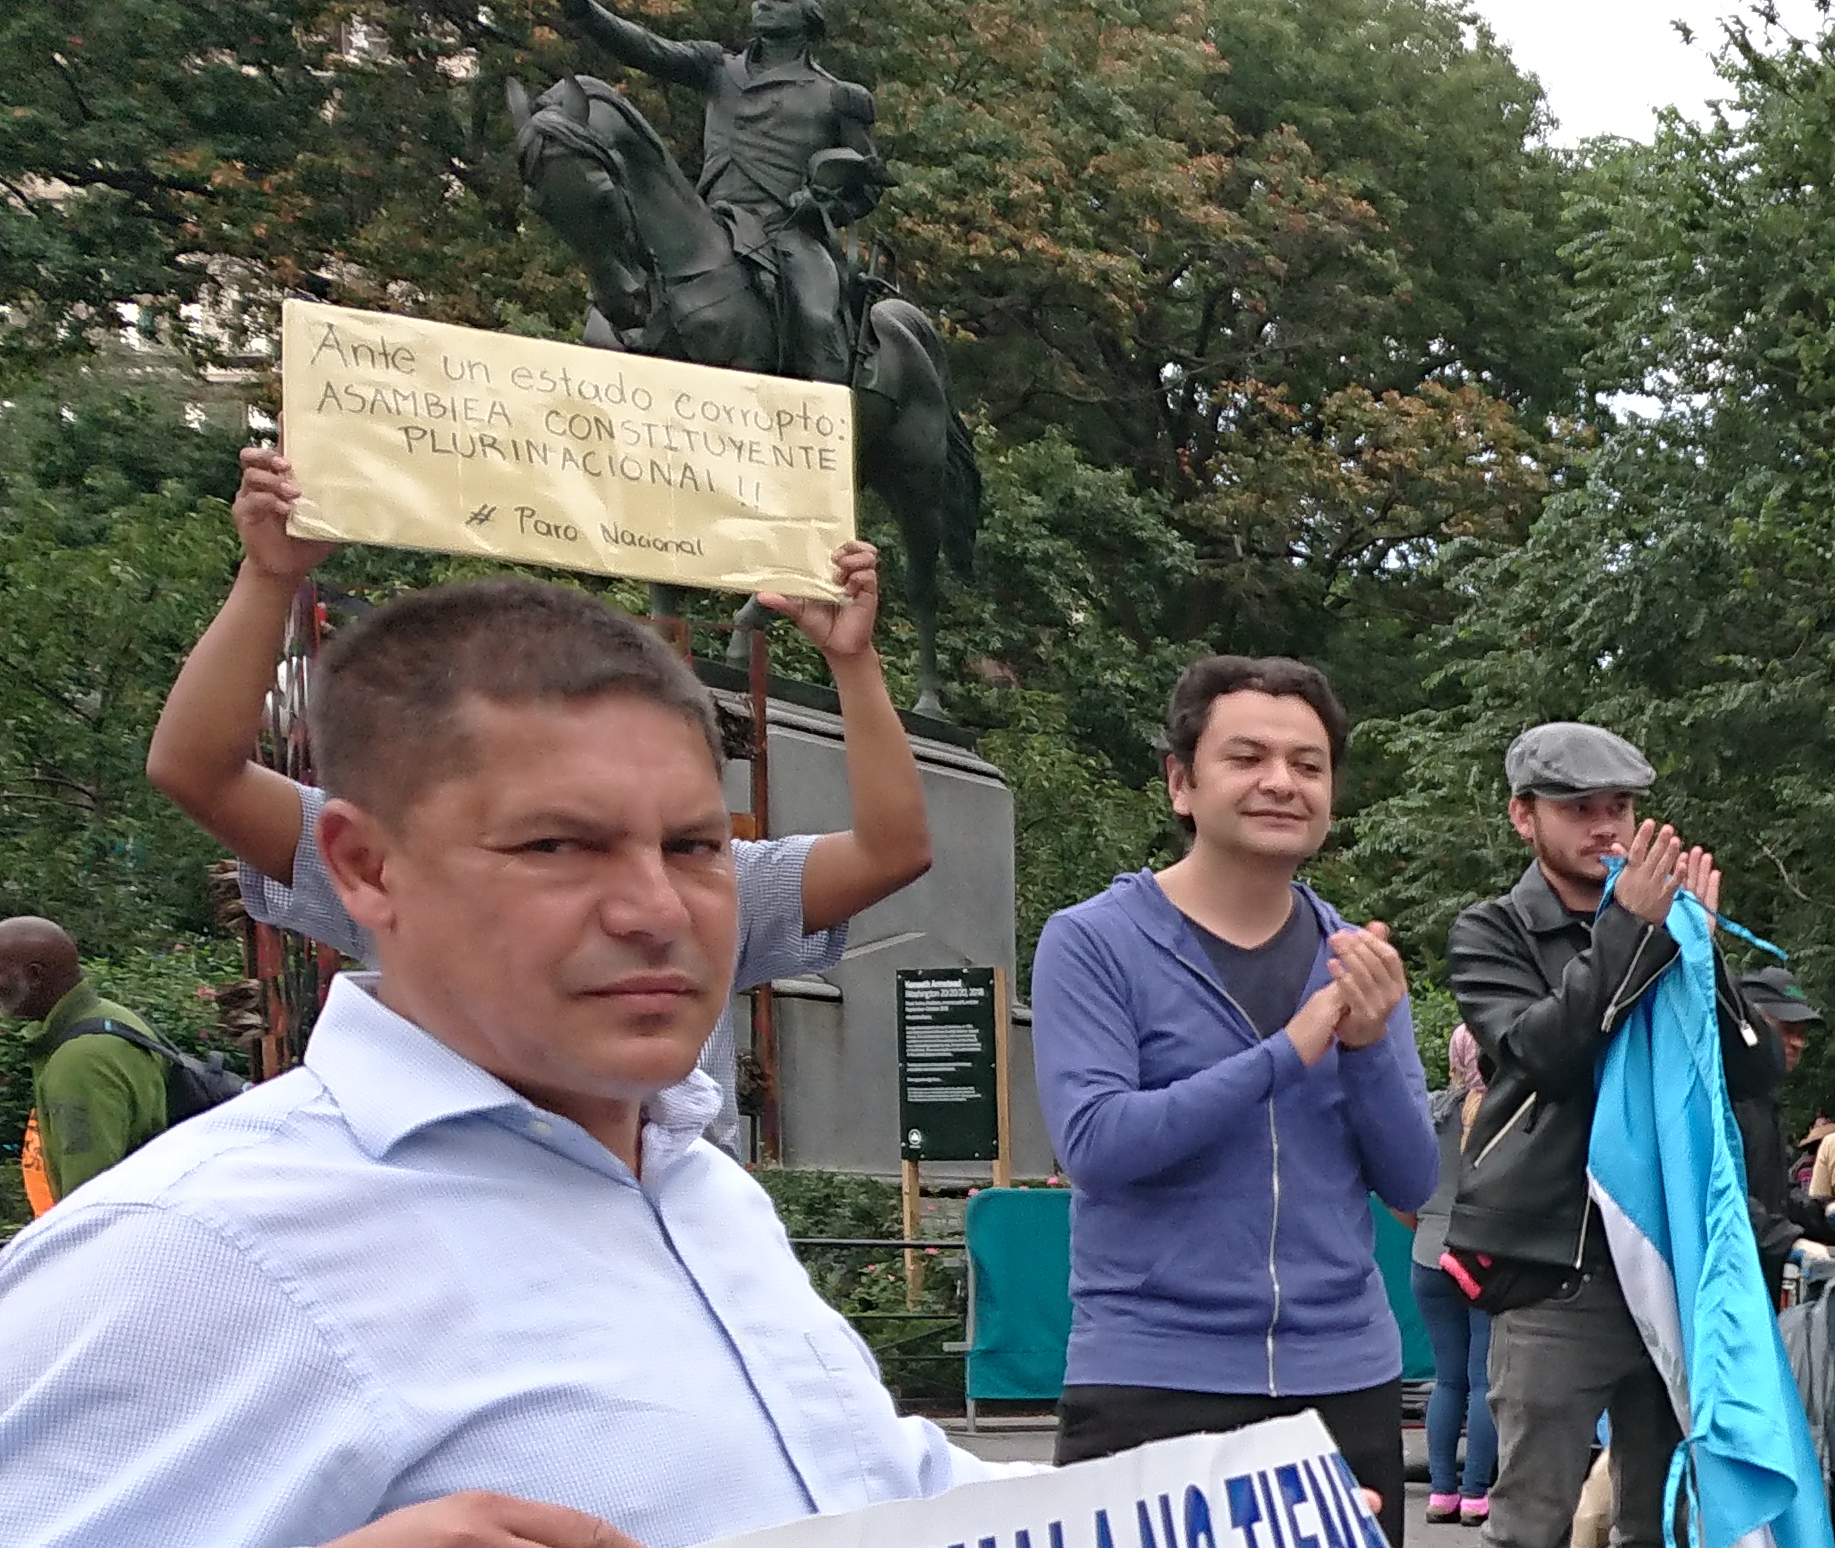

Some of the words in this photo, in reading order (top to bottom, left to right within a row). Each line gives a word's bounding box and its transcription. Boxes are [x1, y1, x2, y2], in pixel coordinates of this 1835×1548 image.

[311, 323, 415, 375] Ante
[443, 354, 491, 383] un
[511, 366, 653, 411] estado
[545, 408, 837, 471] CONSTITUYENTE
[515, 506, 579, 543] Paro
[599, 521, 705, 557] Nacional
